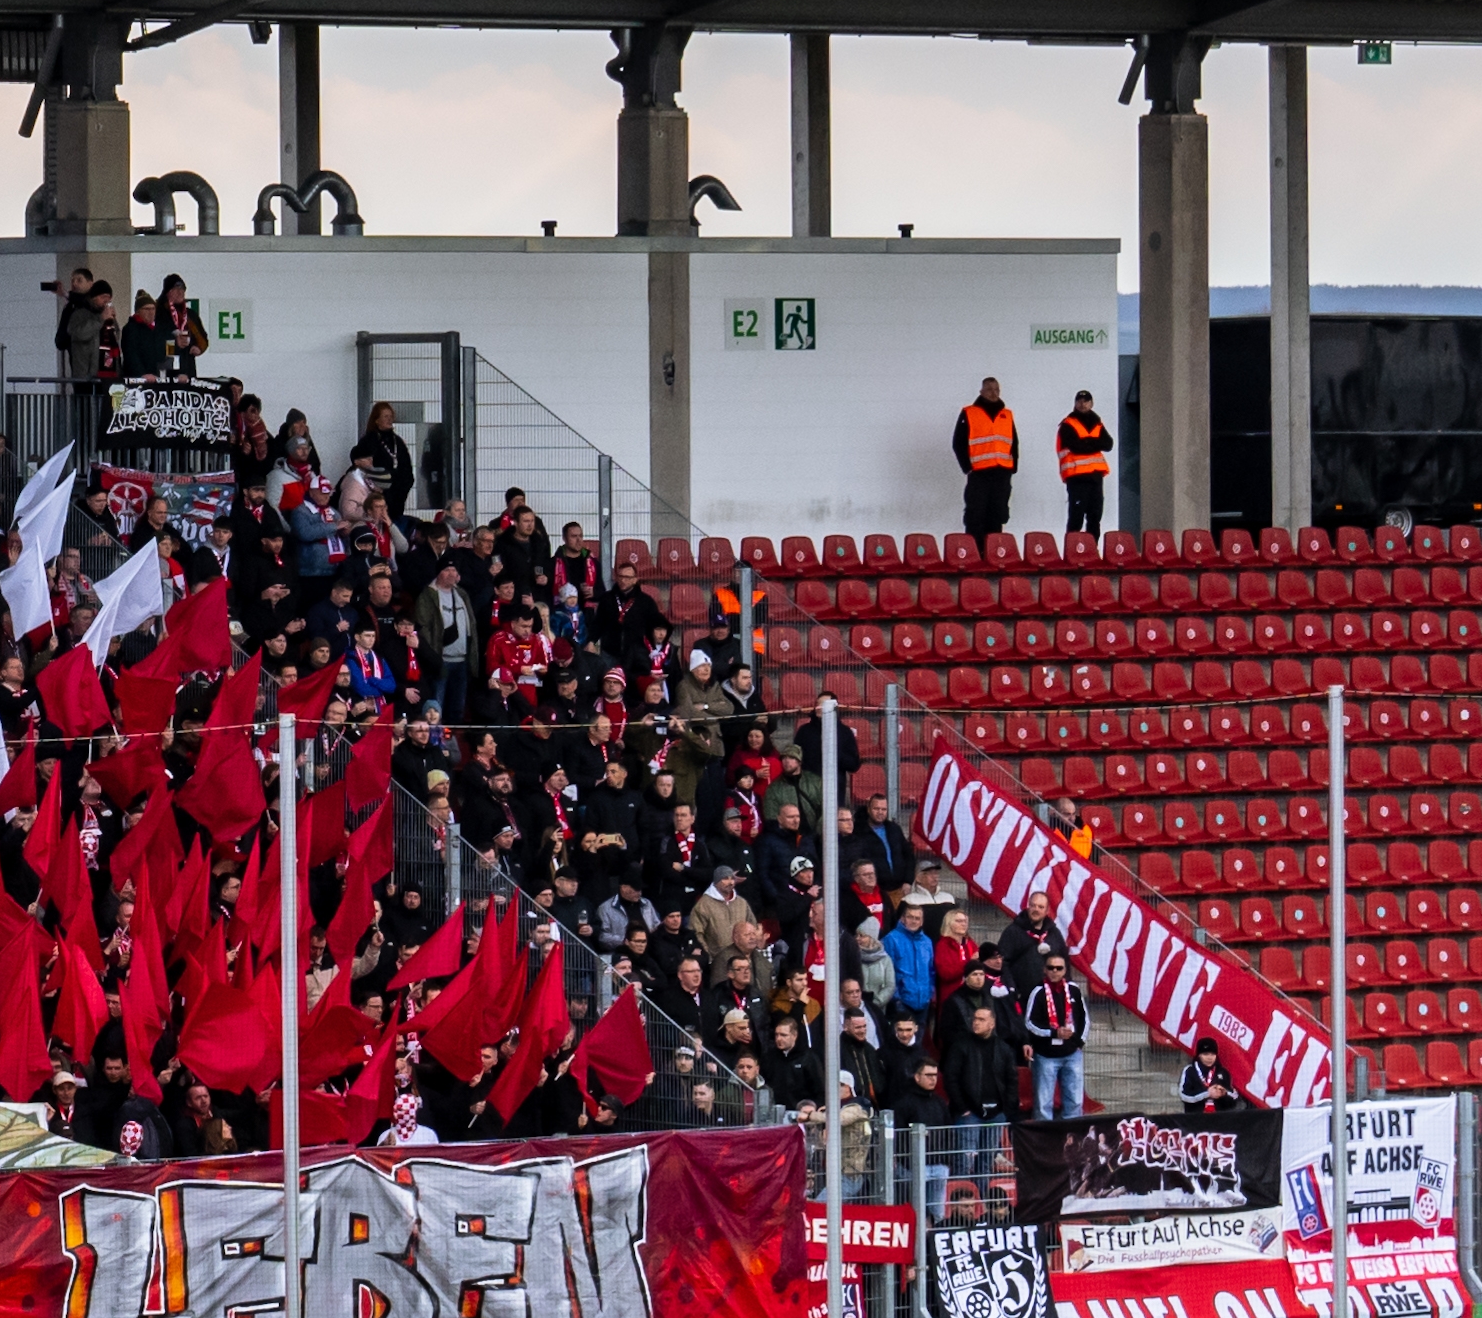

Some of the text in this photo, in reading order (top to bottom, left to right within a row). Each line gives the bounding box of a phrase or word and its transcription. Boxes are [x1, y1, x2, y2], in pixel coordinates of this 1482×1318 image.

[218, 311, 246, 340] E1
[732, 309, 759, 338] E2
[1034, 329, 1095, 345] AUSGANG
[143, 389, 215, 410] BANDA
[106, 409, 231, 435] ALCOHOLICA
[920, 753, 1222, 1050] OSTKURVE
[1217, 1010, 1248, 1045] 1982
[1321, 1144, 1424, 1178] AF ACHSE
[1426, 1162, 1440, 1175] FC
[1419, 1172, 1444, 1189] RWE
[935, 1224, 1038, 1257] ERFURT
[1081, 1225, 1149, 1251] Erfurt
[1186, 1215, 1245, 1240] Achse
[952, 1267, 986, 1286] RWE
[956, 1257, 975, 1271] FC
[1294, 1263, 1317, 1285] FC
[1350, 1256, 1397, 1281] WEISS
[1396, 1250, 1458, 1277] ERFURT
[1376, 1291, 1428, 1314] RWE
